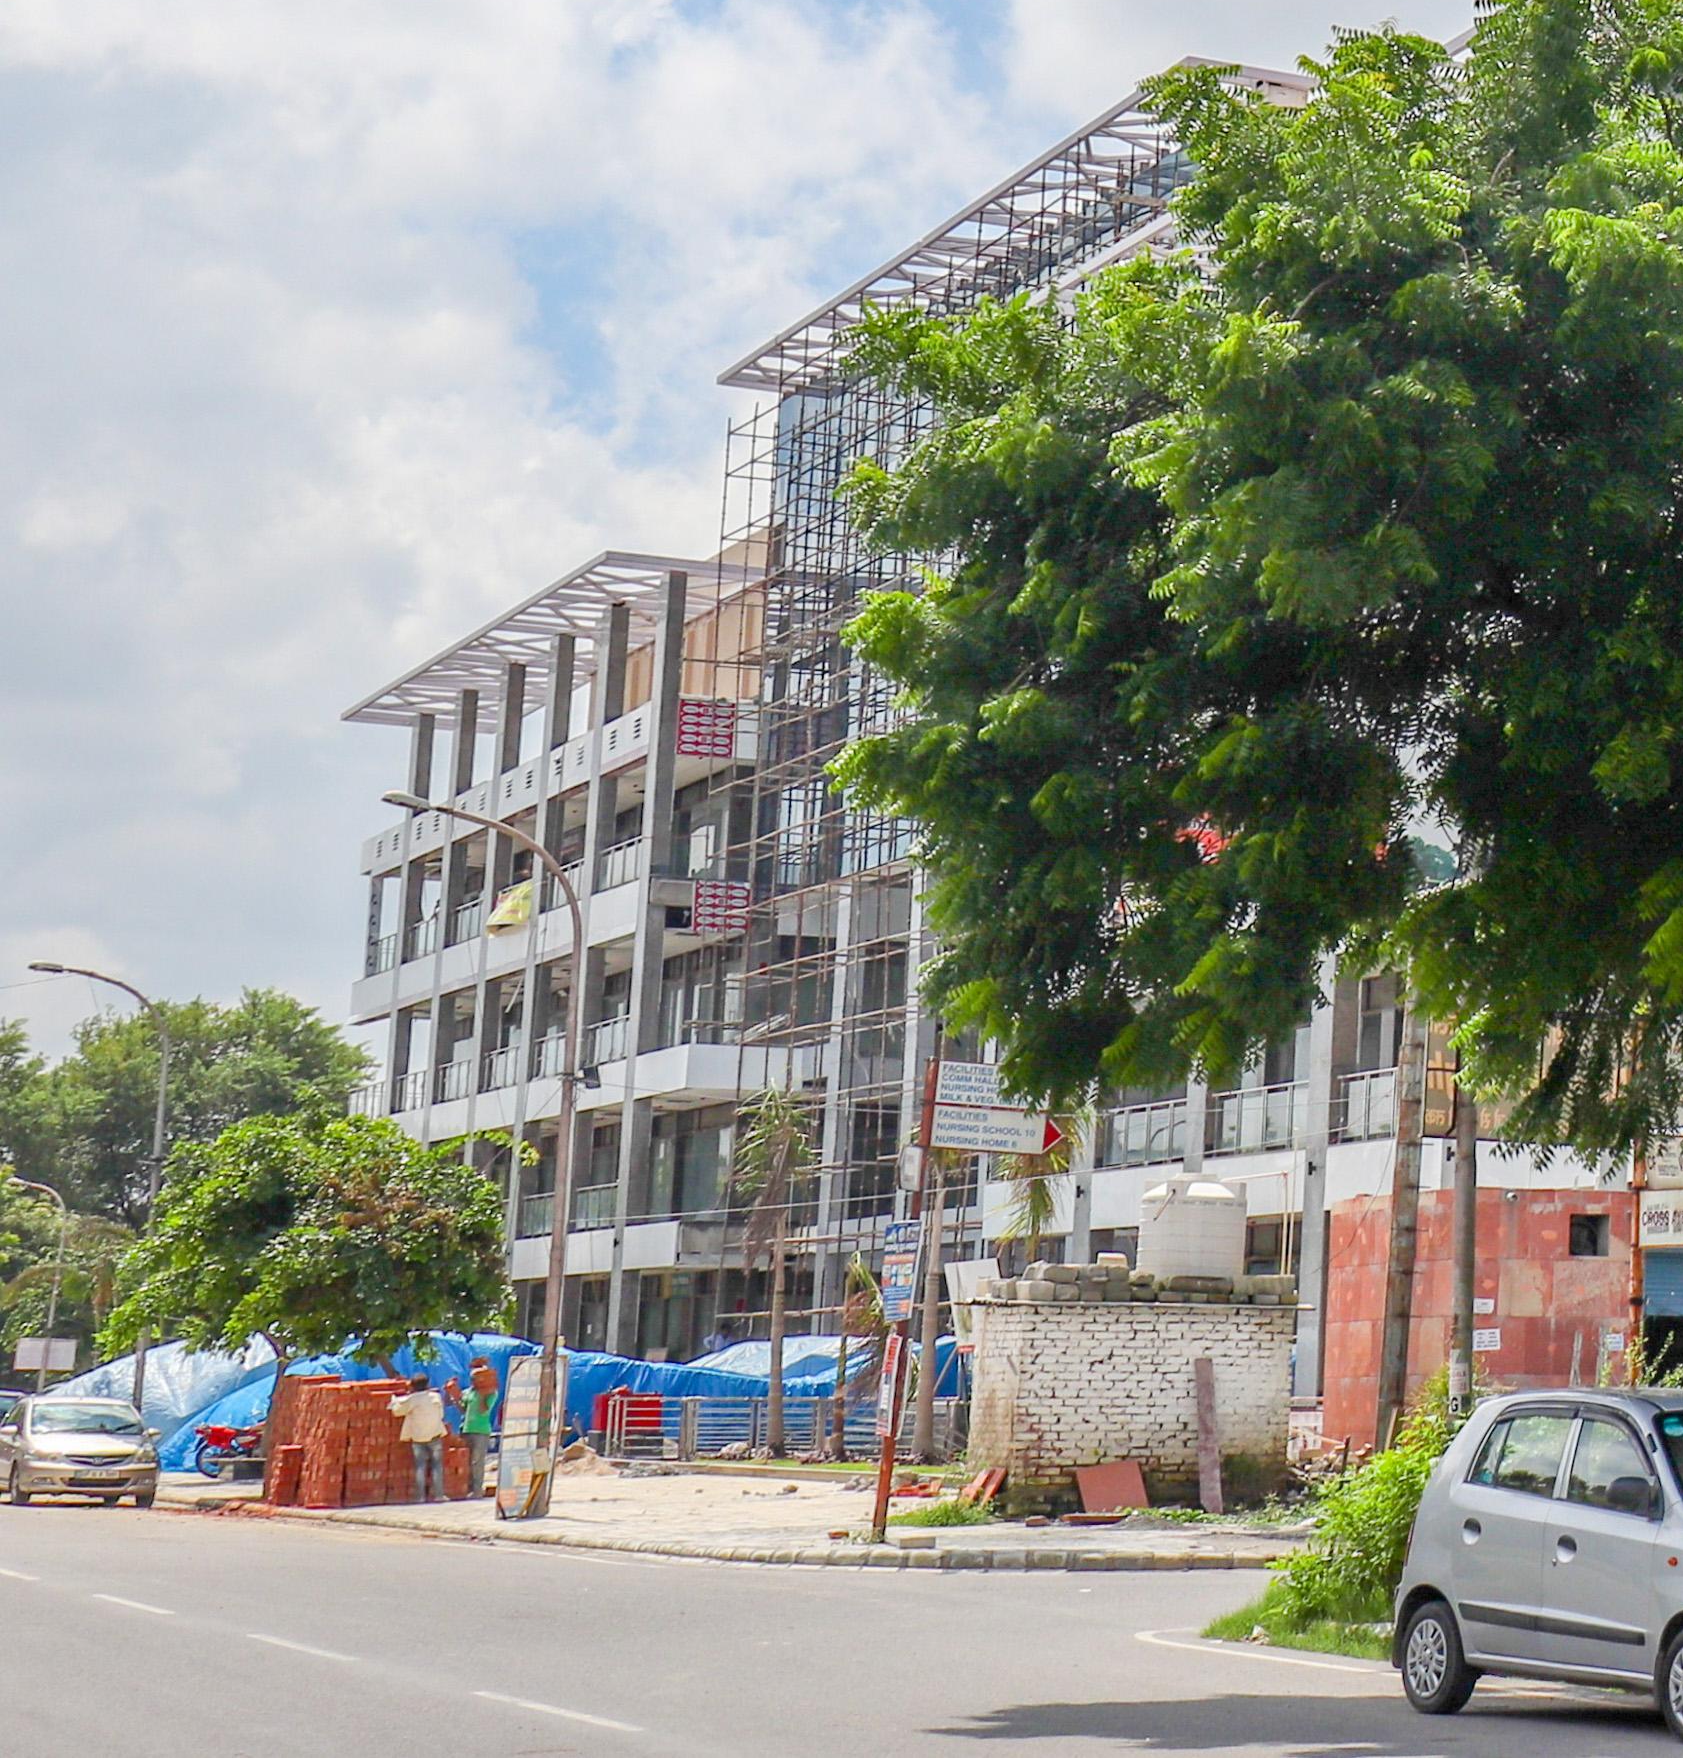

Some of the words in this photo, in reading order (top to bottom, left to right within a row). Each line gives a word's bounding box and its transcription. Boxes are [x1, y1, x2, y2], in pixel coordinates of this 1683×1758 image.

[943, 1064, 993, 1076] FACILITIES
[940, 1083, 984, 1094] NURSING
[939, 1093, 962, 1102] MILK
[937, 1110, 988, 1121] FACILITIES
[936, 1122, 980, 1133] NURSING
[982, 1125, 1022, 1137] SCHOOL
[935, 1135, 980, 1146] NURSING
[981, 1137, 1009, 1148] HOME
